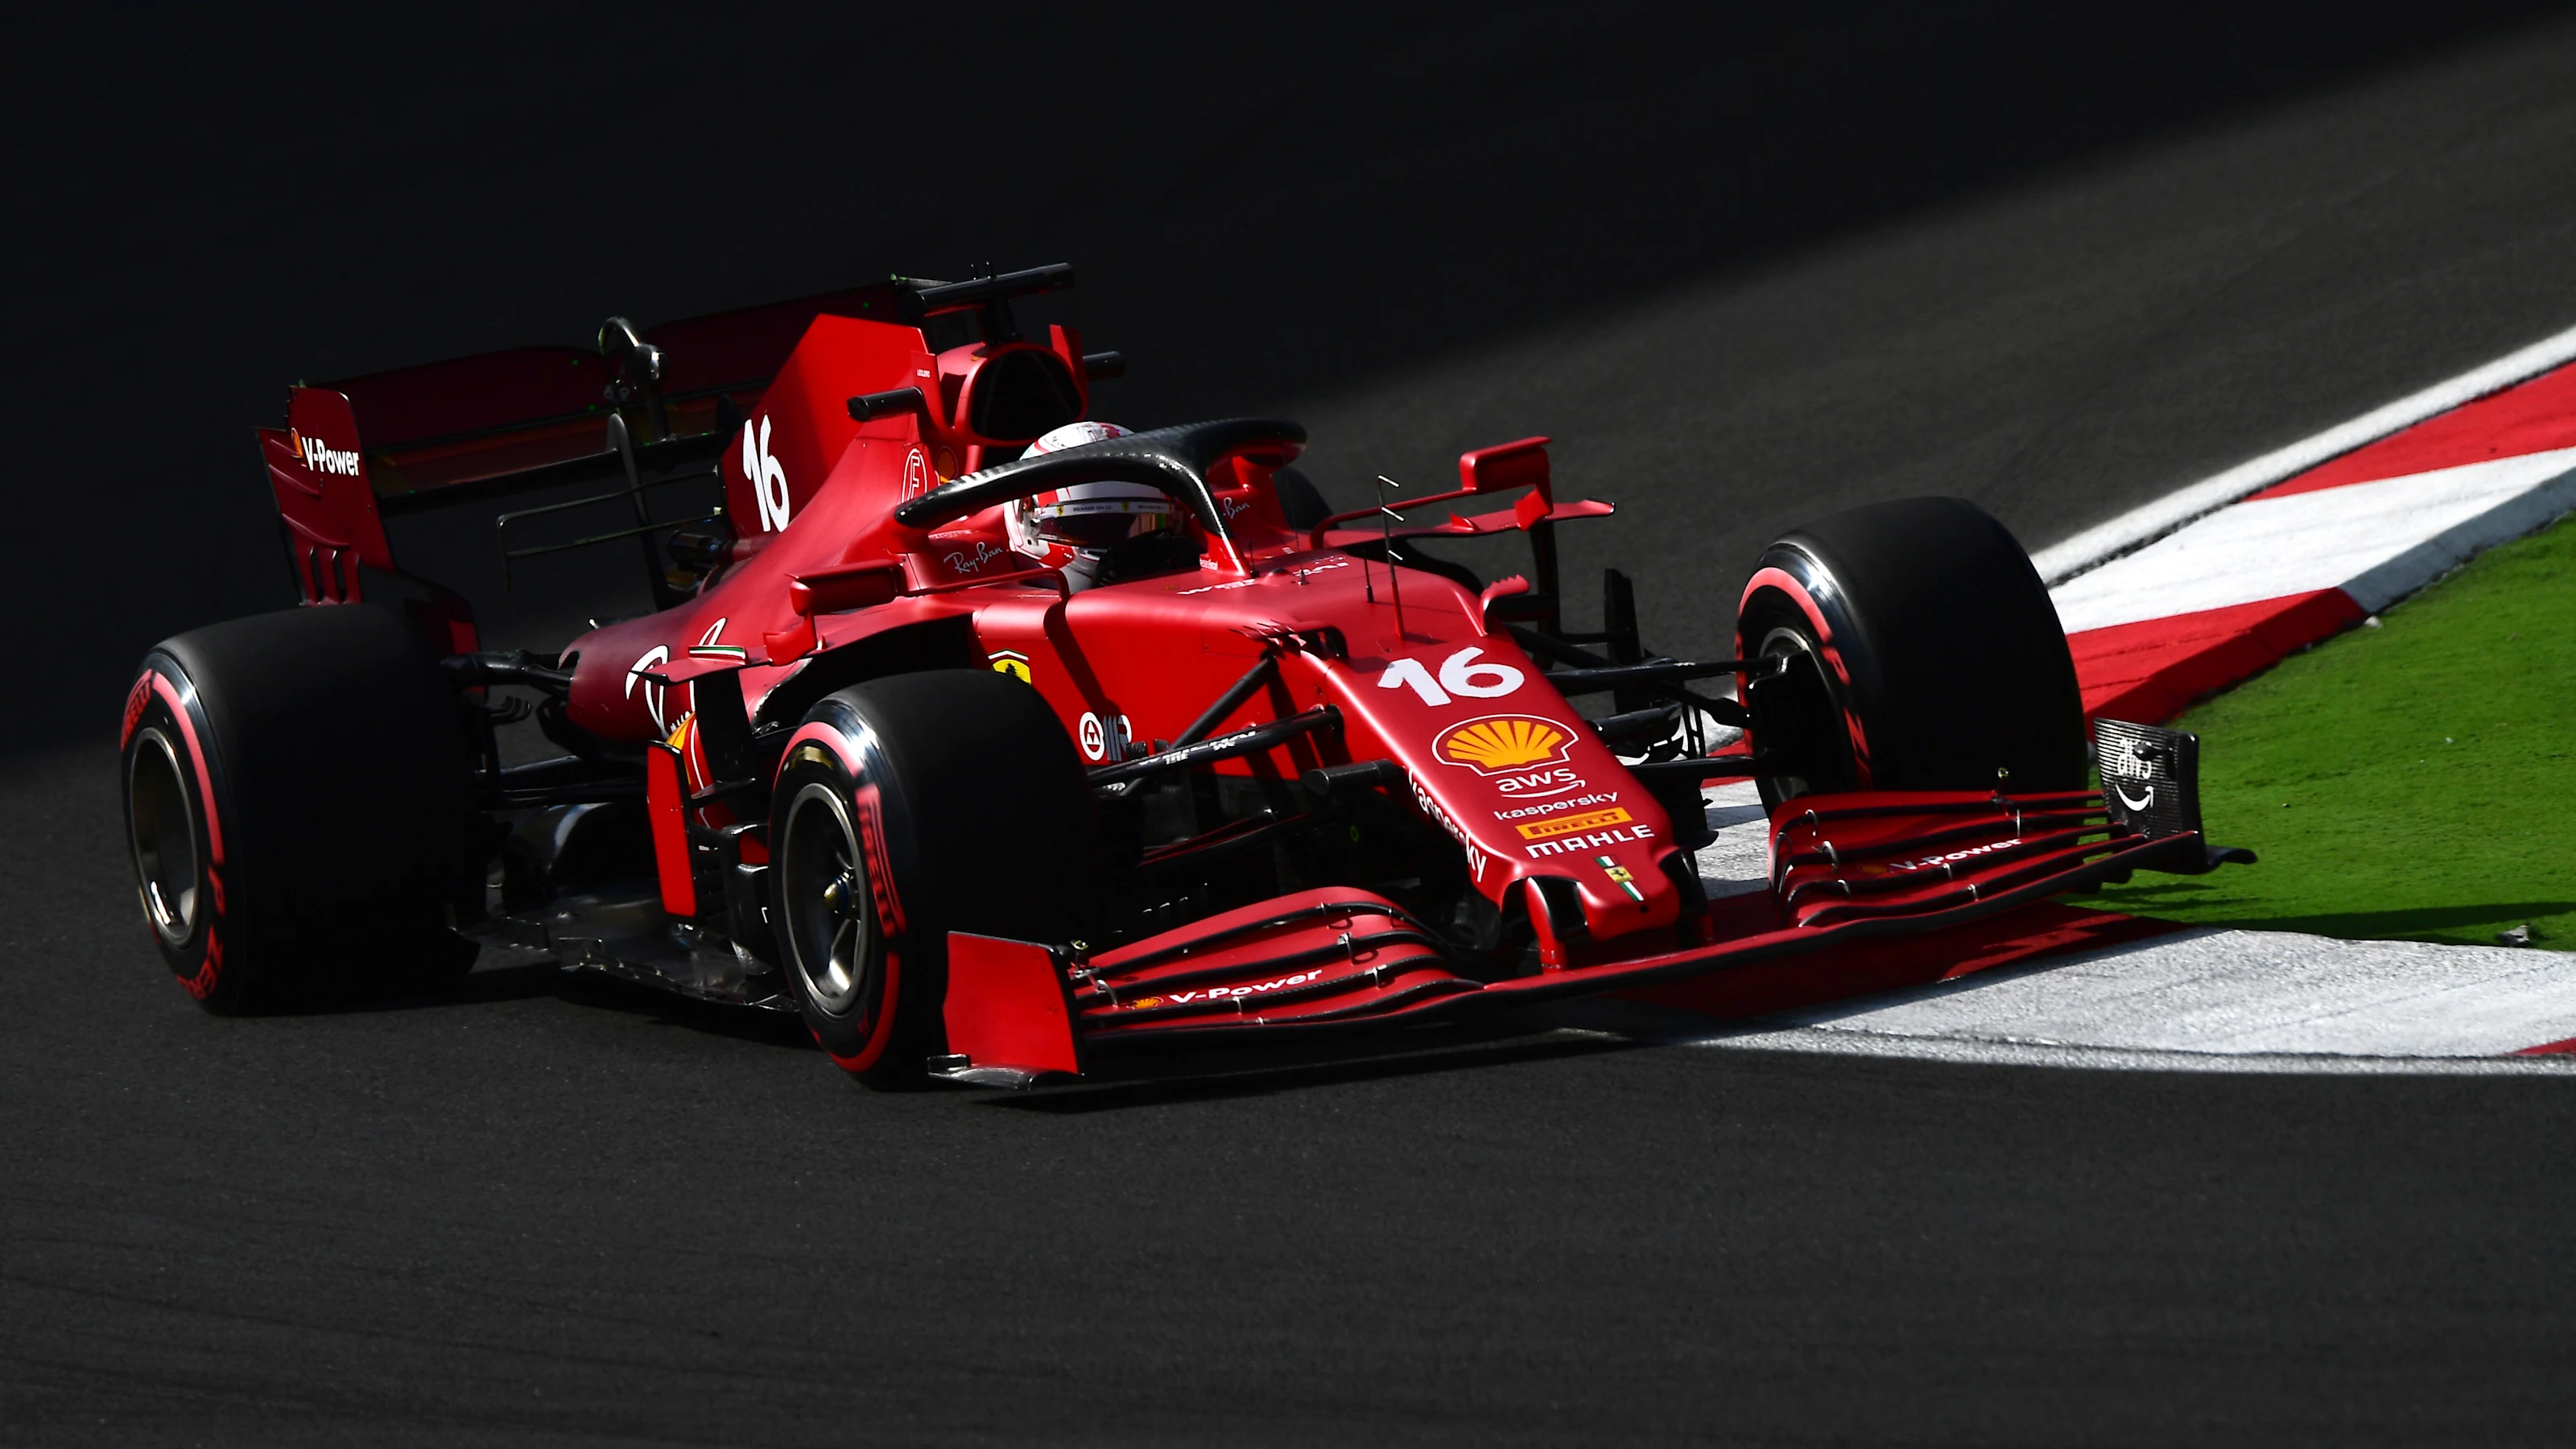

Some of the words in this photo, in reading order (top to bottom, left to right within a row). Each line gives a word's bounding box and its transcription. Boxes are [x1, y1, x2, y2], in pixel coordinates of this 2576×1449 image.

[301, 436, 359, 477] V-Power
[742, 414, 791, 533] 16
[943, 542, 1003, 574] Ray-Ban
[1377, 646, 1525, 708] 16
[1495, 768, 1577, 792] aws
[1493, 791, 1618, 820] kaspersky
[1527, 811, 1621, 836] PIRELLI
[1525, 824, 1655, 859] MAHLE
[1889, 838, 2022, 870] V-Power
[1169, 969, 1323, 1004] V-Power
